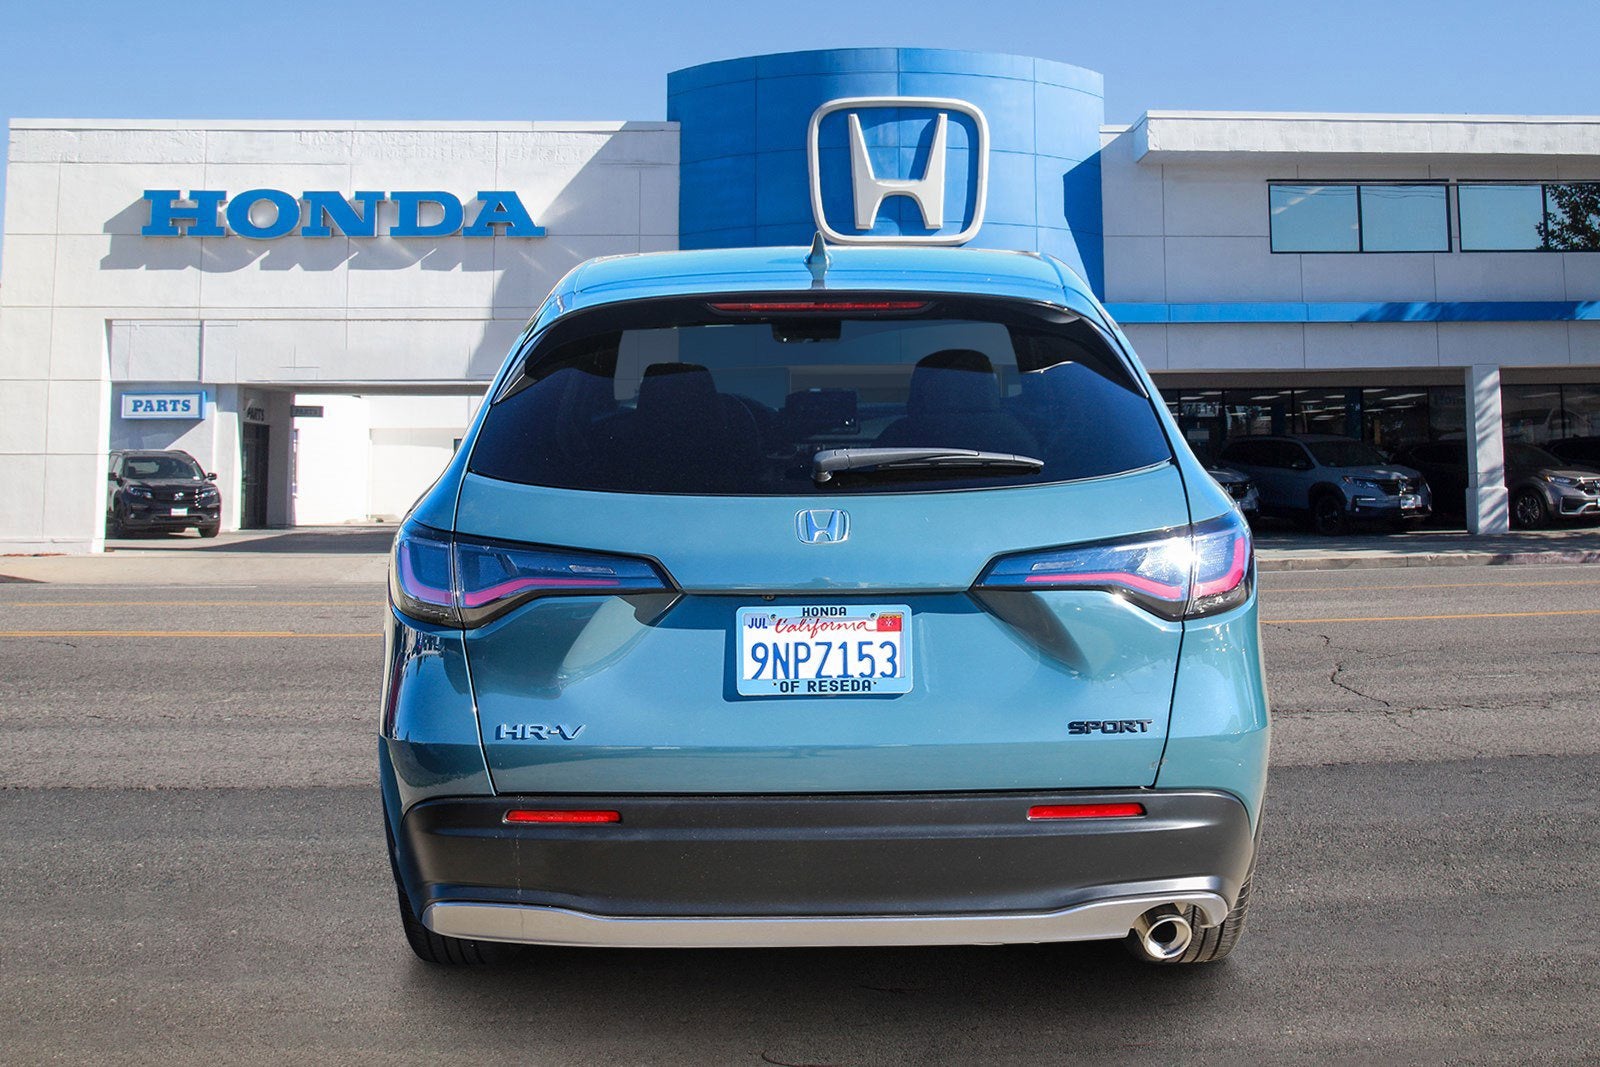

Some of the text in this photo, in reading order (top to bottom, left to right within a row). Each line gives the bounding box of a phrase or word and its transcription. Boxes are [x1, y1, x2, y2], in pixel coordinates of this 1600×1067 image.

[141, 188, 547, 239] HONDA
[132, 399, 191, 412] PARTS
[802, 606, 847, 617] HONDA
[747, 617, 768, 629] JUL
[774, 617, 873, 639] California
[751, 641, 898, 680] 9NPZ153
[779, 680, 872, 692] OF RESEDA
[497, 724, 586, 740] HR-V
[1068, 719, 1153, 734] SPORT
